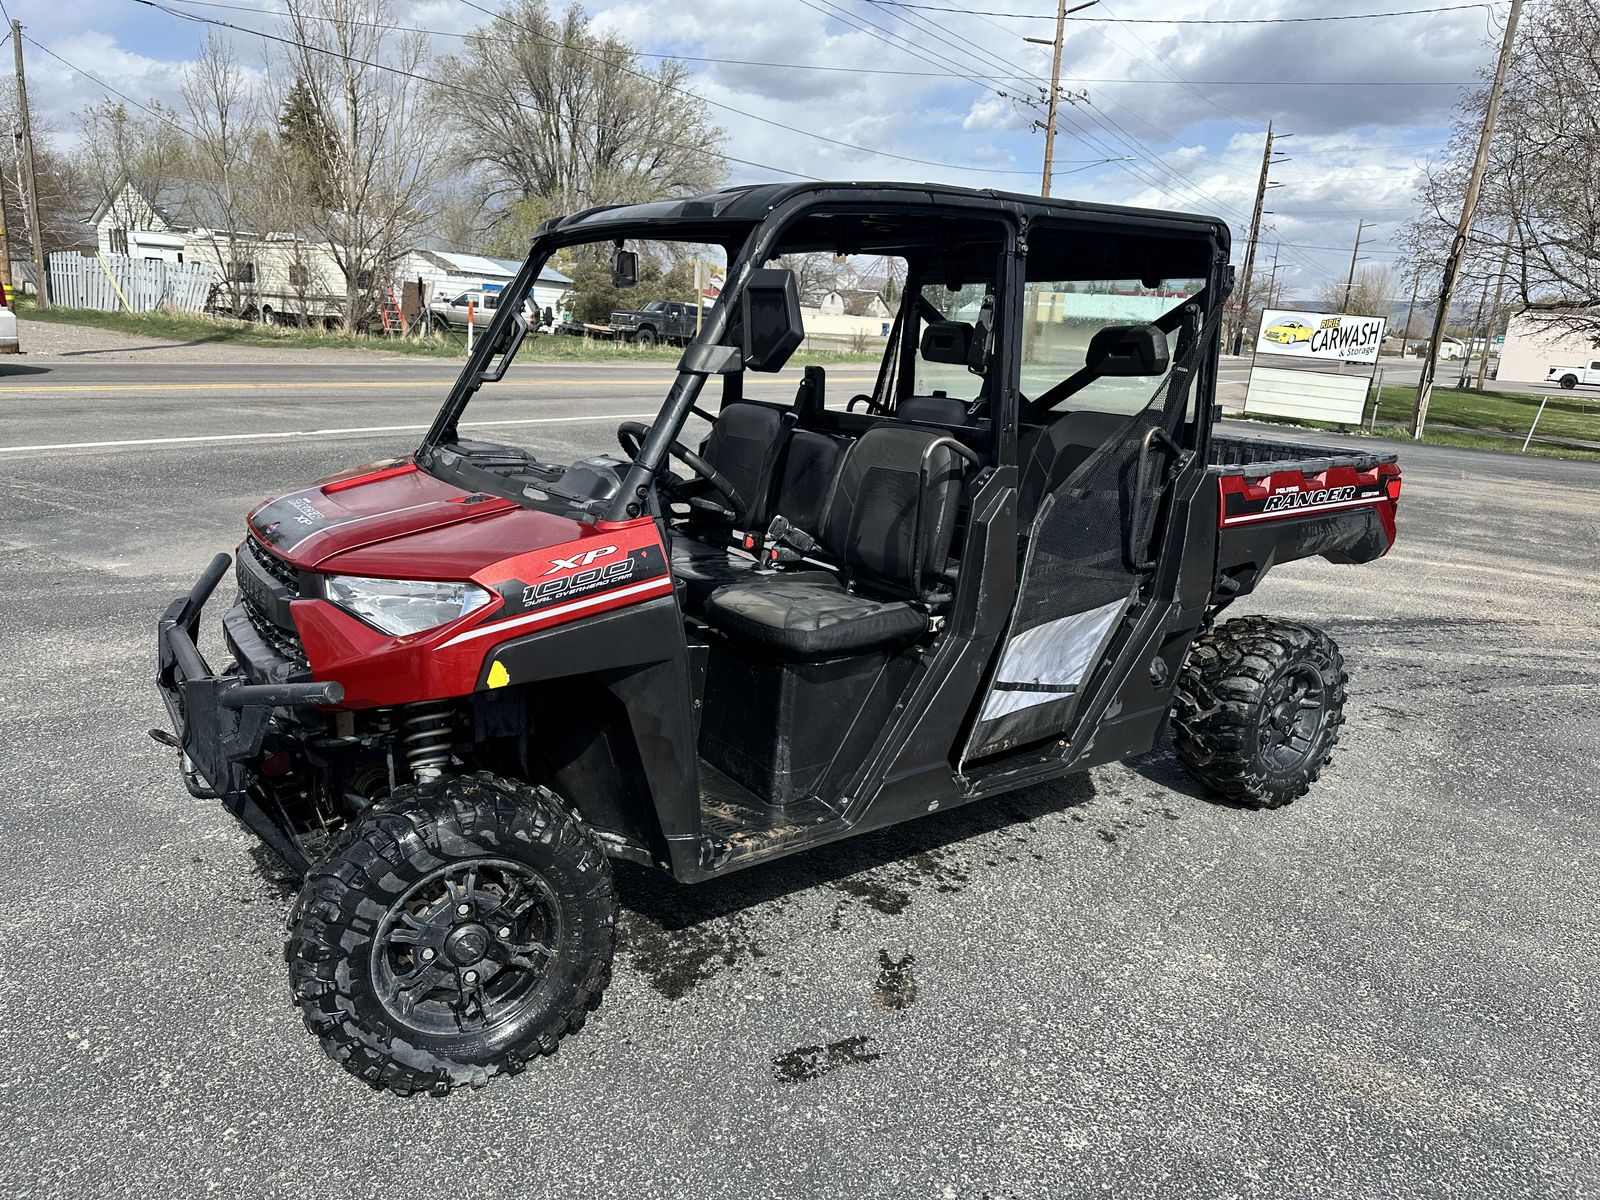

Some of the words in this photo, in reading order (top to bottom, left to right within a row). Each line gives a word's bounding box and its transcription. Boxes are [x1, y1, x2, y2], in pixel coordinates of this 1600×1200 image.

[1311, 321, 1381, 353] CARWASH
[1320, 317, 1342, 330] RIRIE
[1346, 346, 1375, 357] Storage
[1263, 486, 1356, 513] RANGER
[1275, 486, 1300, 495] POLARIS
[293, 515, 313, 525] XP
[541, 545, 619, 577] XP
[522, 557, 635, 603] 1000
[524, 596, 553, 608] DUAL
[555, 579, 609, 598] OVERHEAD
[610, 572, 633, 583] CAM
